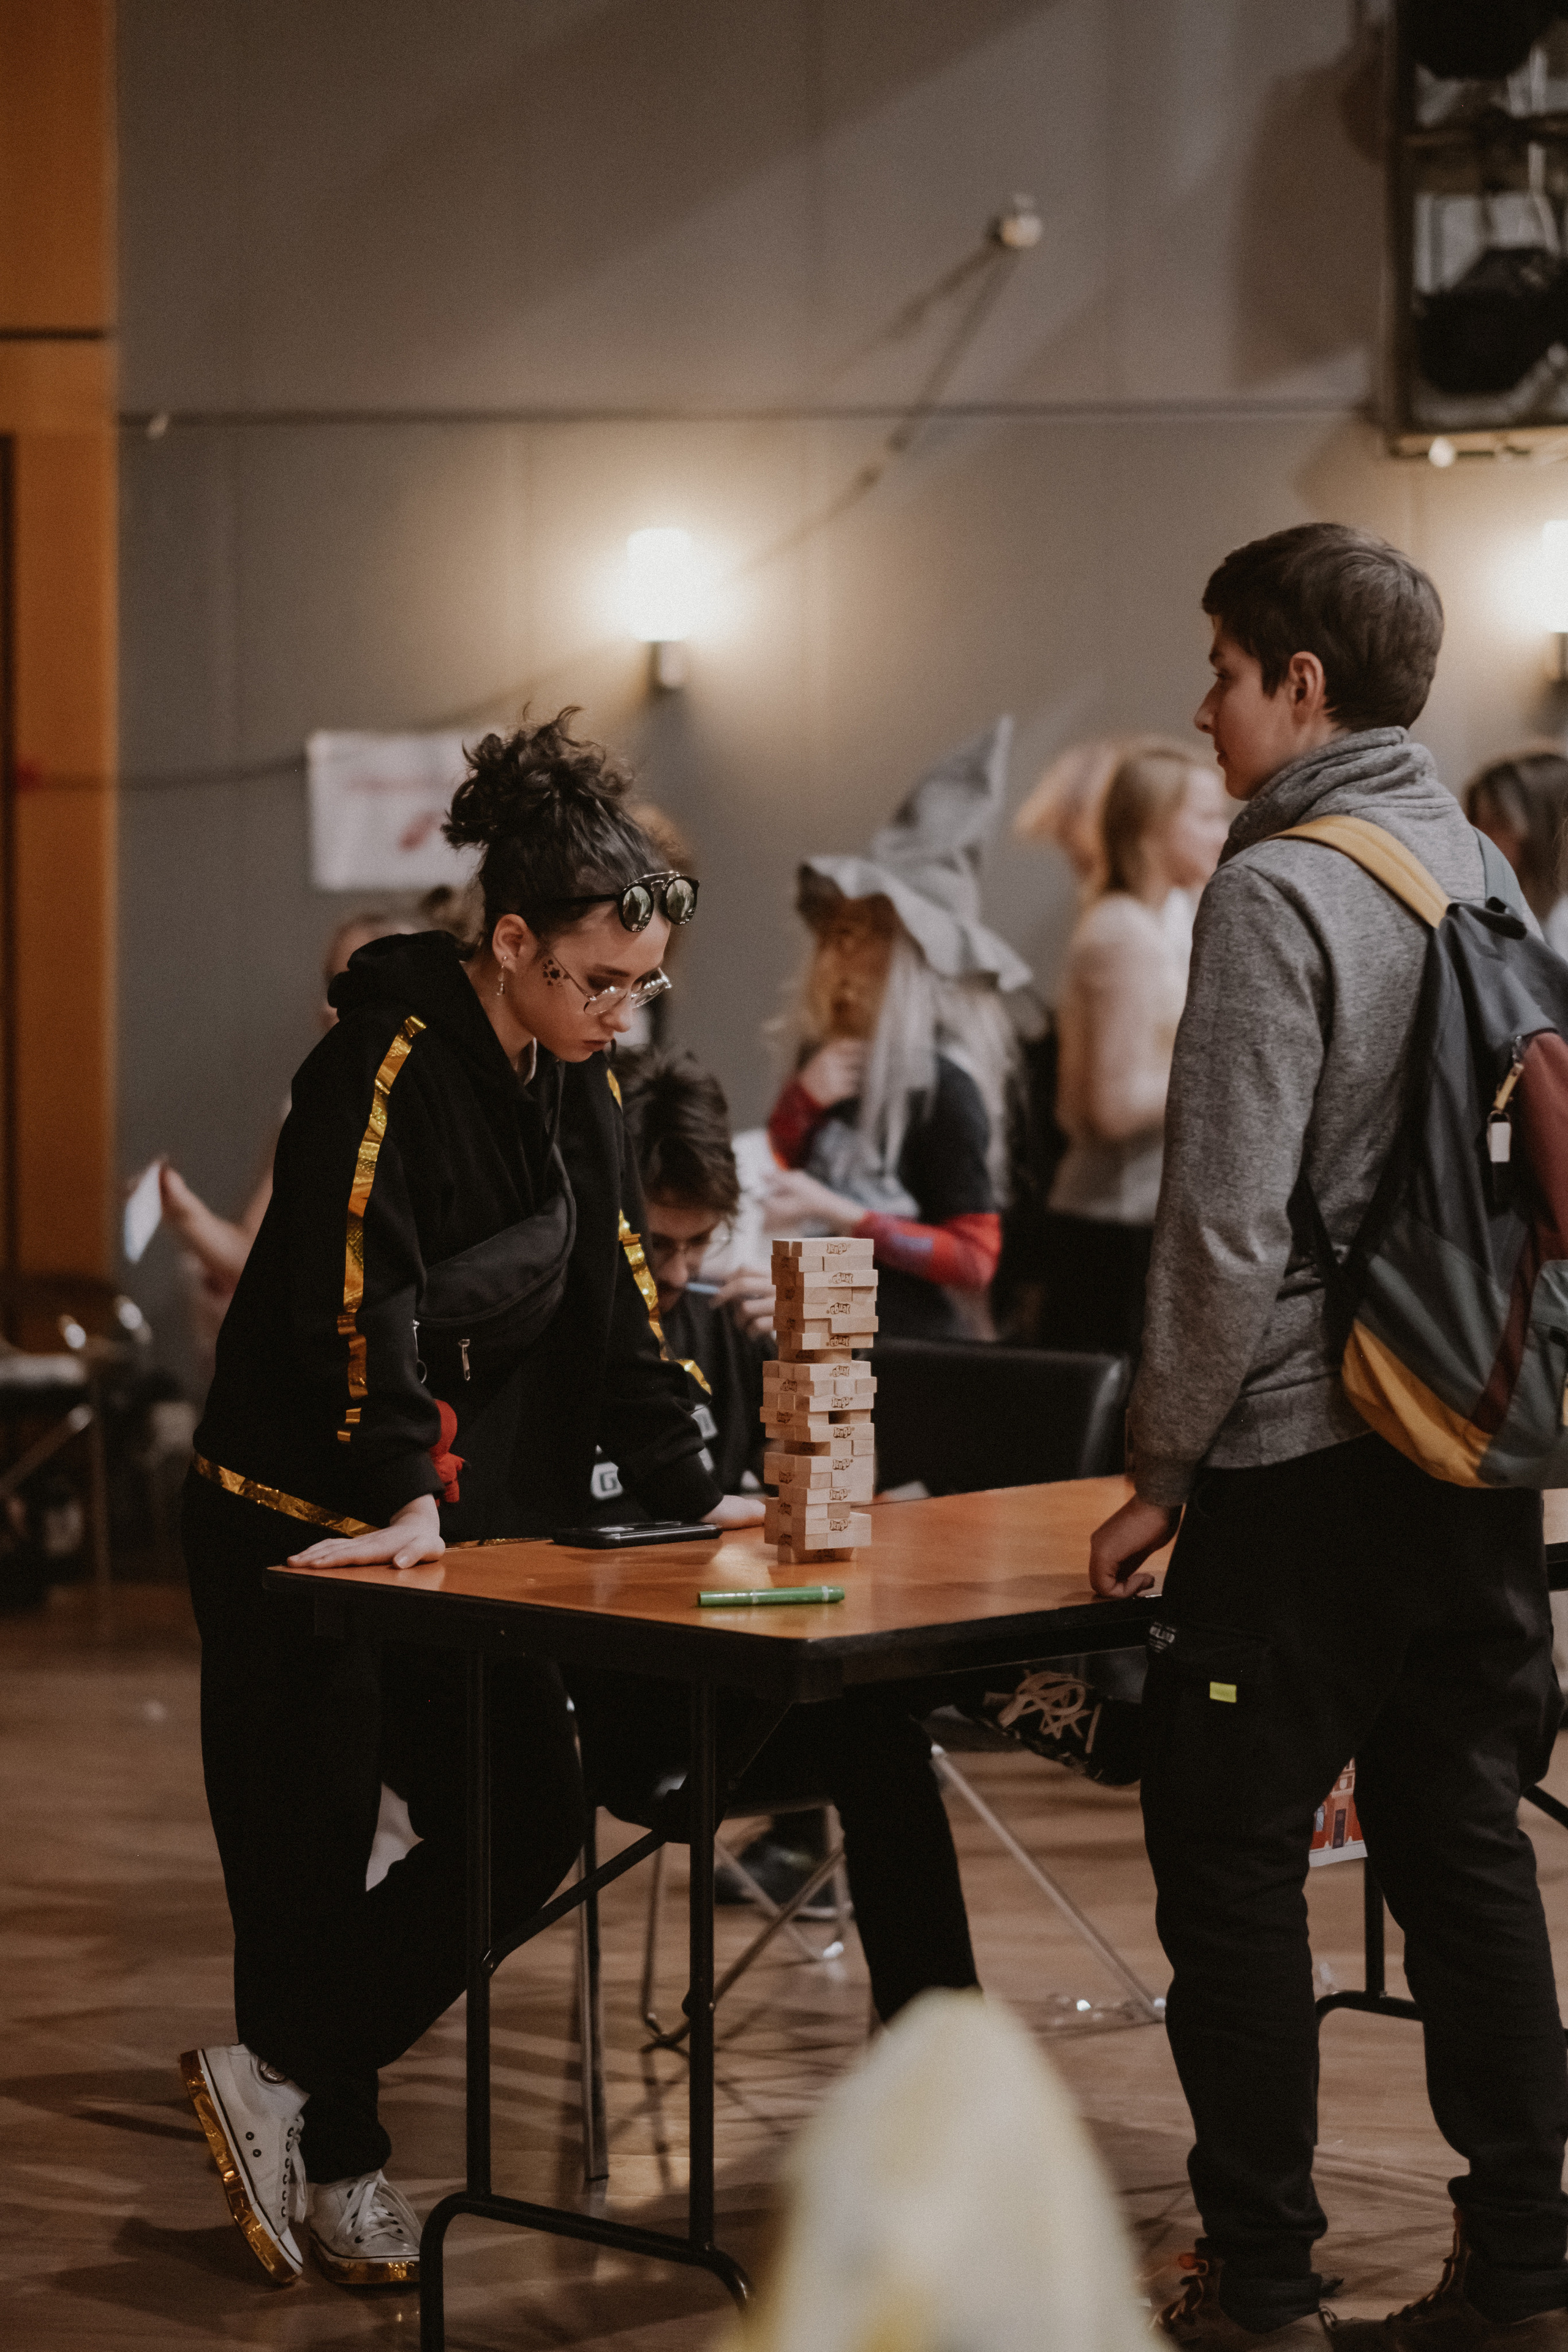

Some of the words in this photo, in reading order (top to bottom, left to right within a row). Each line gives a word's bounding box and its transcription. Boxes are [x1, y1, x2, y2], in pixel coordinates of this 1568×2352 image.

[826, 1243, 848, 1254] Jenga
[832, 1272, 853, 1284] Jenga
[830, 1302, 851, 1314] Jenga
[829, 1335, 850, 1347] Jenga
[832, 1365, 850, 1378] Jenga
[831, 1396, 850, 1408] Jenga
[833, 1426, 851, 1438] Jenga
[832, 1458, 850, 1470] Jenga
[829, 1488, 848, 1501] Jenga
[829, 1519, 848, 1531] Jenga
